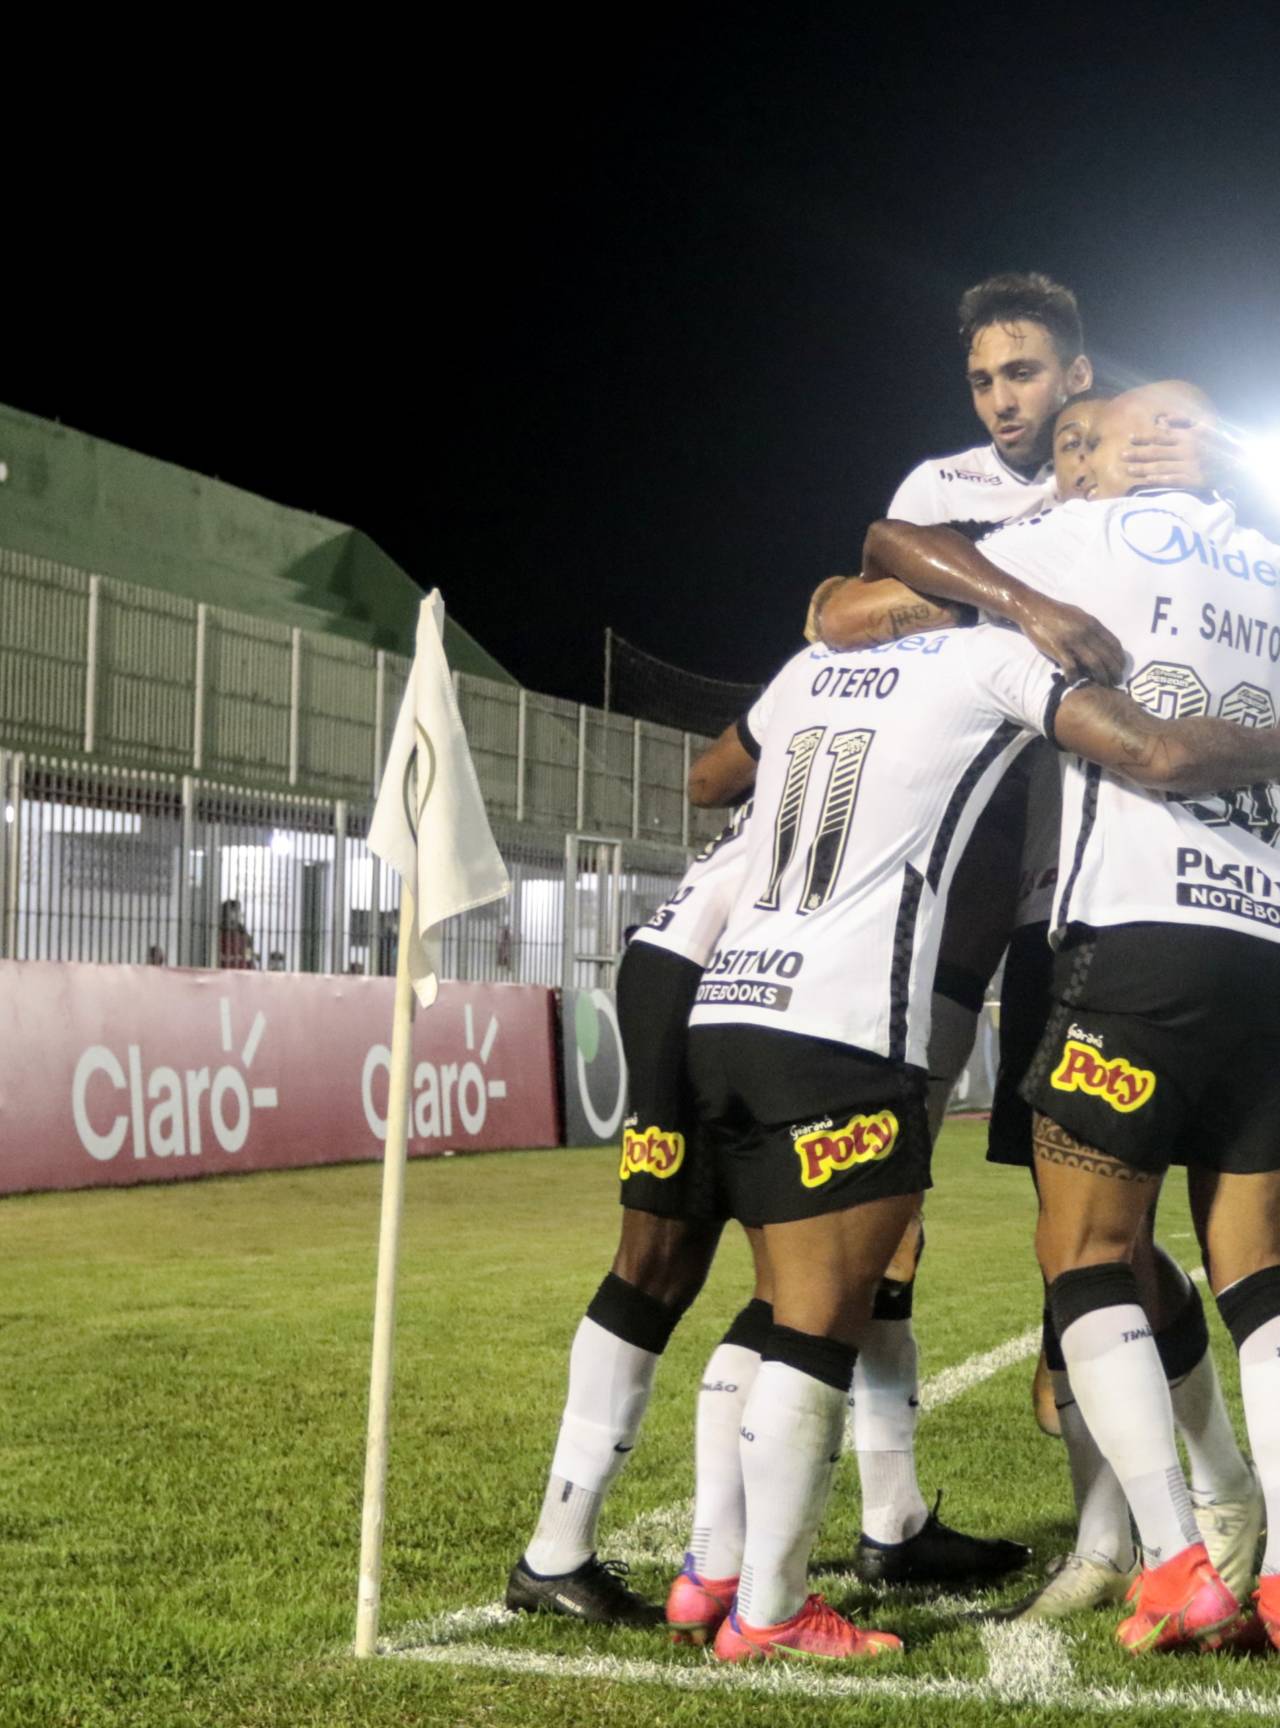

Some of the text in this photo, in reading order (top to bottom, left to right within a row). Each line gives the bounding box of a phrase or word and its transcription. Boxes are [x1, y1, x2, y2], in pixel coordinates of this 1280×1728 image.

[1151, 596, 1178, 635] F.
[811, 667, 899, 699] OTERO
[753, 726, 876, 916] 11
[696, 983, 778, 1005] OTEBOOKS
[73, 1042, 251, 1162] Claro
[361, 1043, 487, 1140] Caro
[1057, 1047, 1149, 1106] Poty
[801, 1117, 895, 1180] Poty
